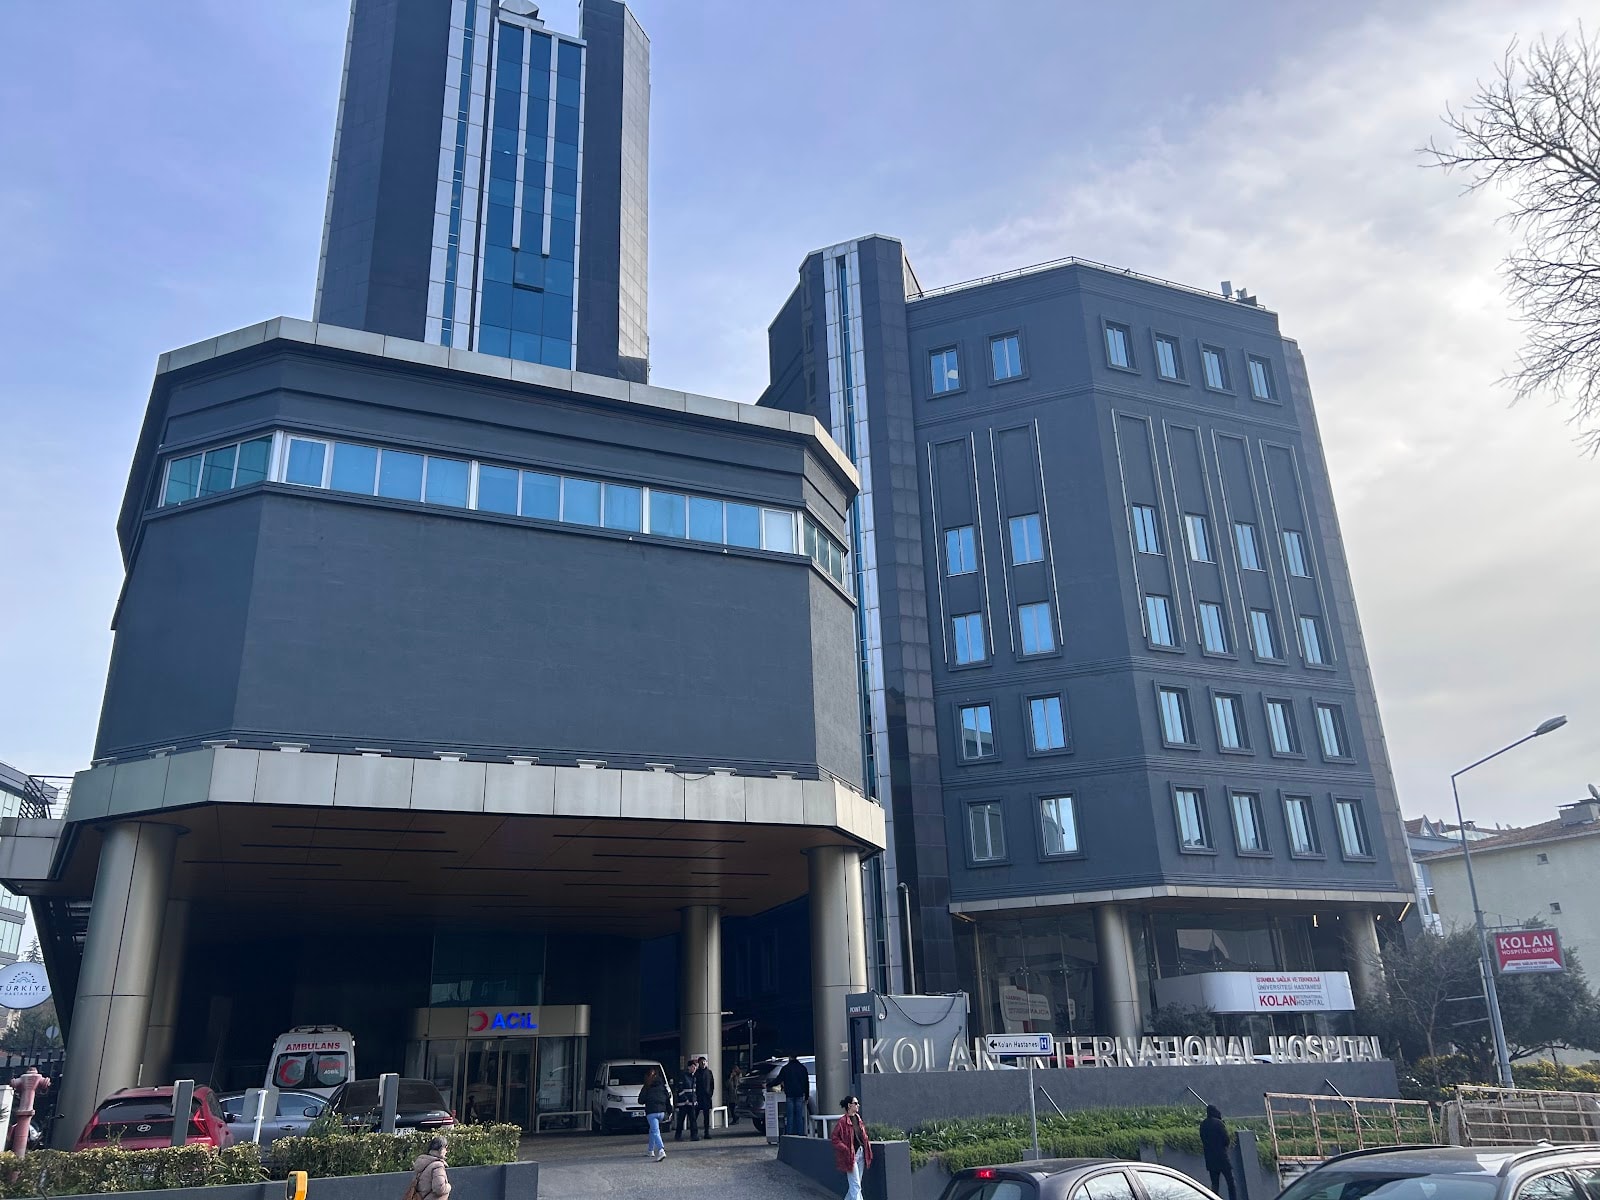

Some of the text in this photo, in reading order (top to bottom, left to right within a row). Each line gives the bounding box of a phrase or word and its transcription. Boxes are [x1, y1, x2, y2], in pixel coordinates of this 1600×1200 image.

[1500, 935, 1554, 949] KOLAN
[1260, 995, 1297, 1006] KOLAN
[285, 1042, 341, 1051] AMBULANS
[1268, 1034, 1384, 1063] HOSPITAL
